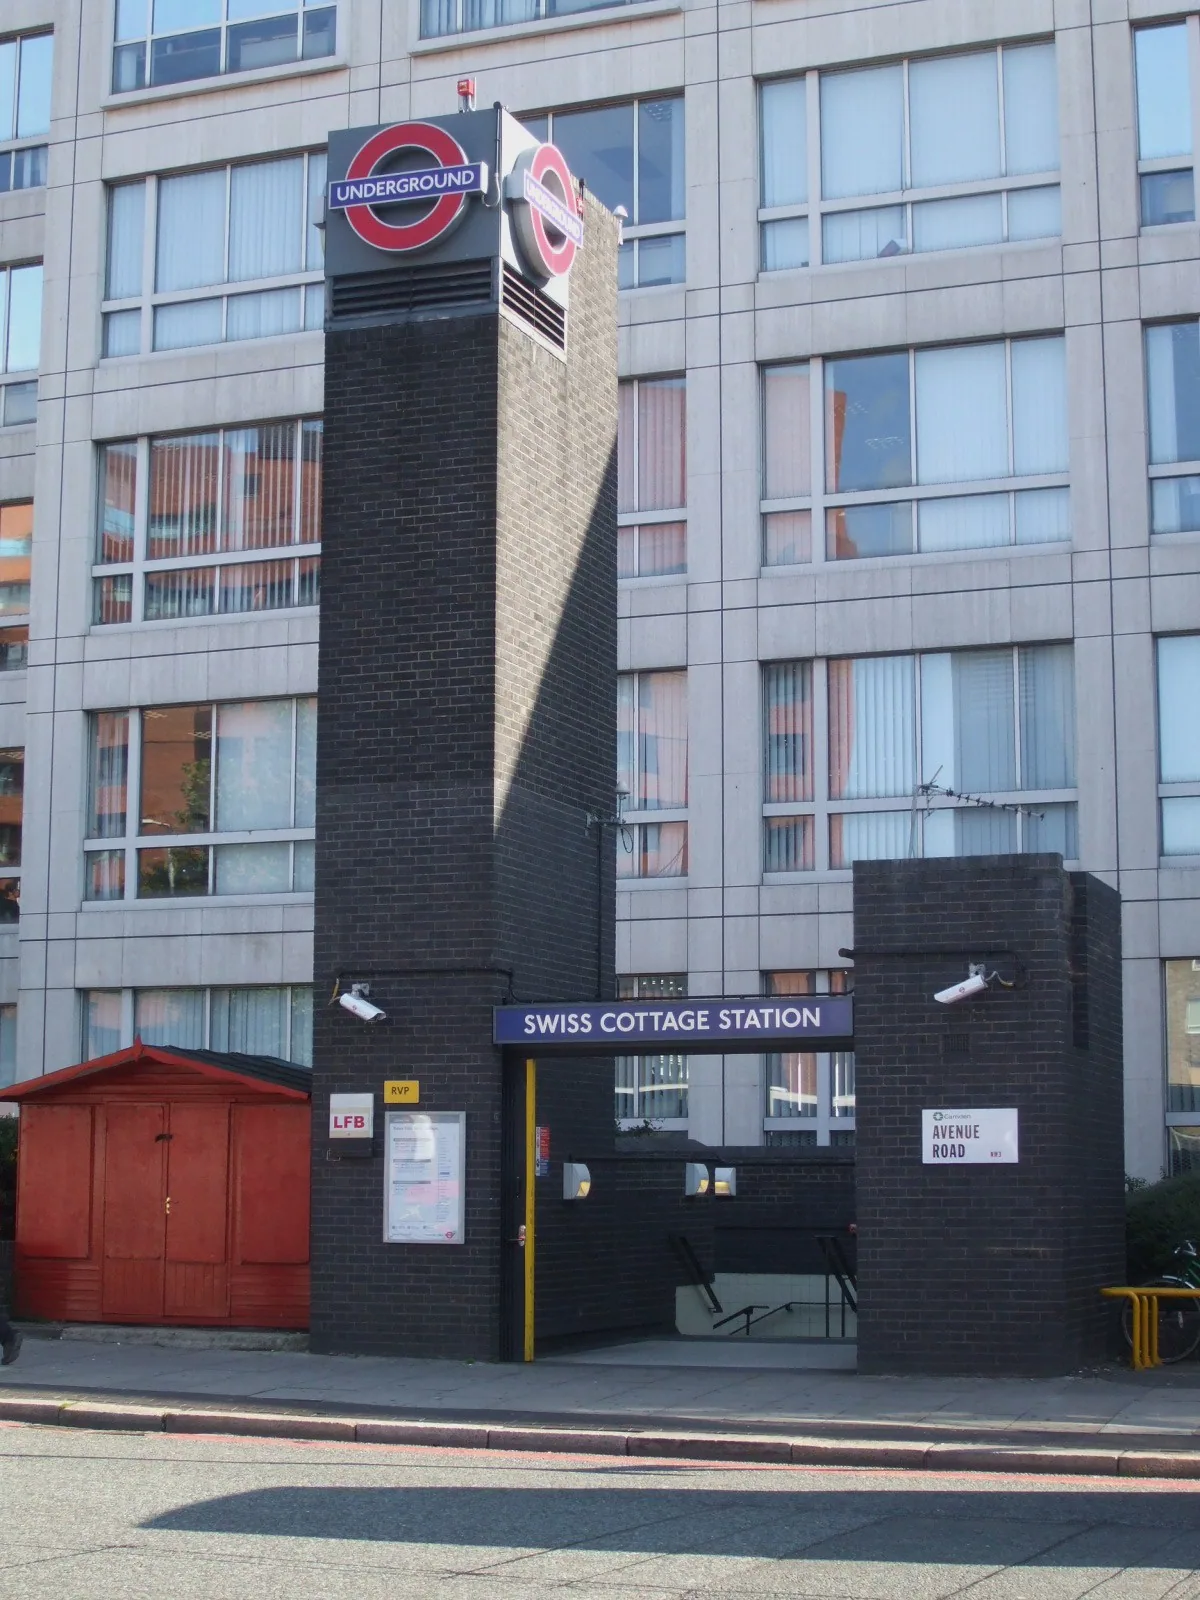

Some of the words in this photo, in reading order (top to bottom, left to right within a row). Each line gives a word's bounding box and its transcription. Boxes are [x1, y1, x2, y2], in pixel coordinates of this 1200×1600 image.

[336, 170, 475, 201] UNDERGROUND
[524, 1013, 592, 1035] SWISS
[600, 1010, 710, 1033] COTTAGE
[718, 1007, 821, 1030] STATION
[391, 1086, 410, 1095] RVP
[333, 1116, 365, 1128] LFB
[933, 1124, 980, 1139] AVENUE
[932, 1144, 966, 1158] ROAD
